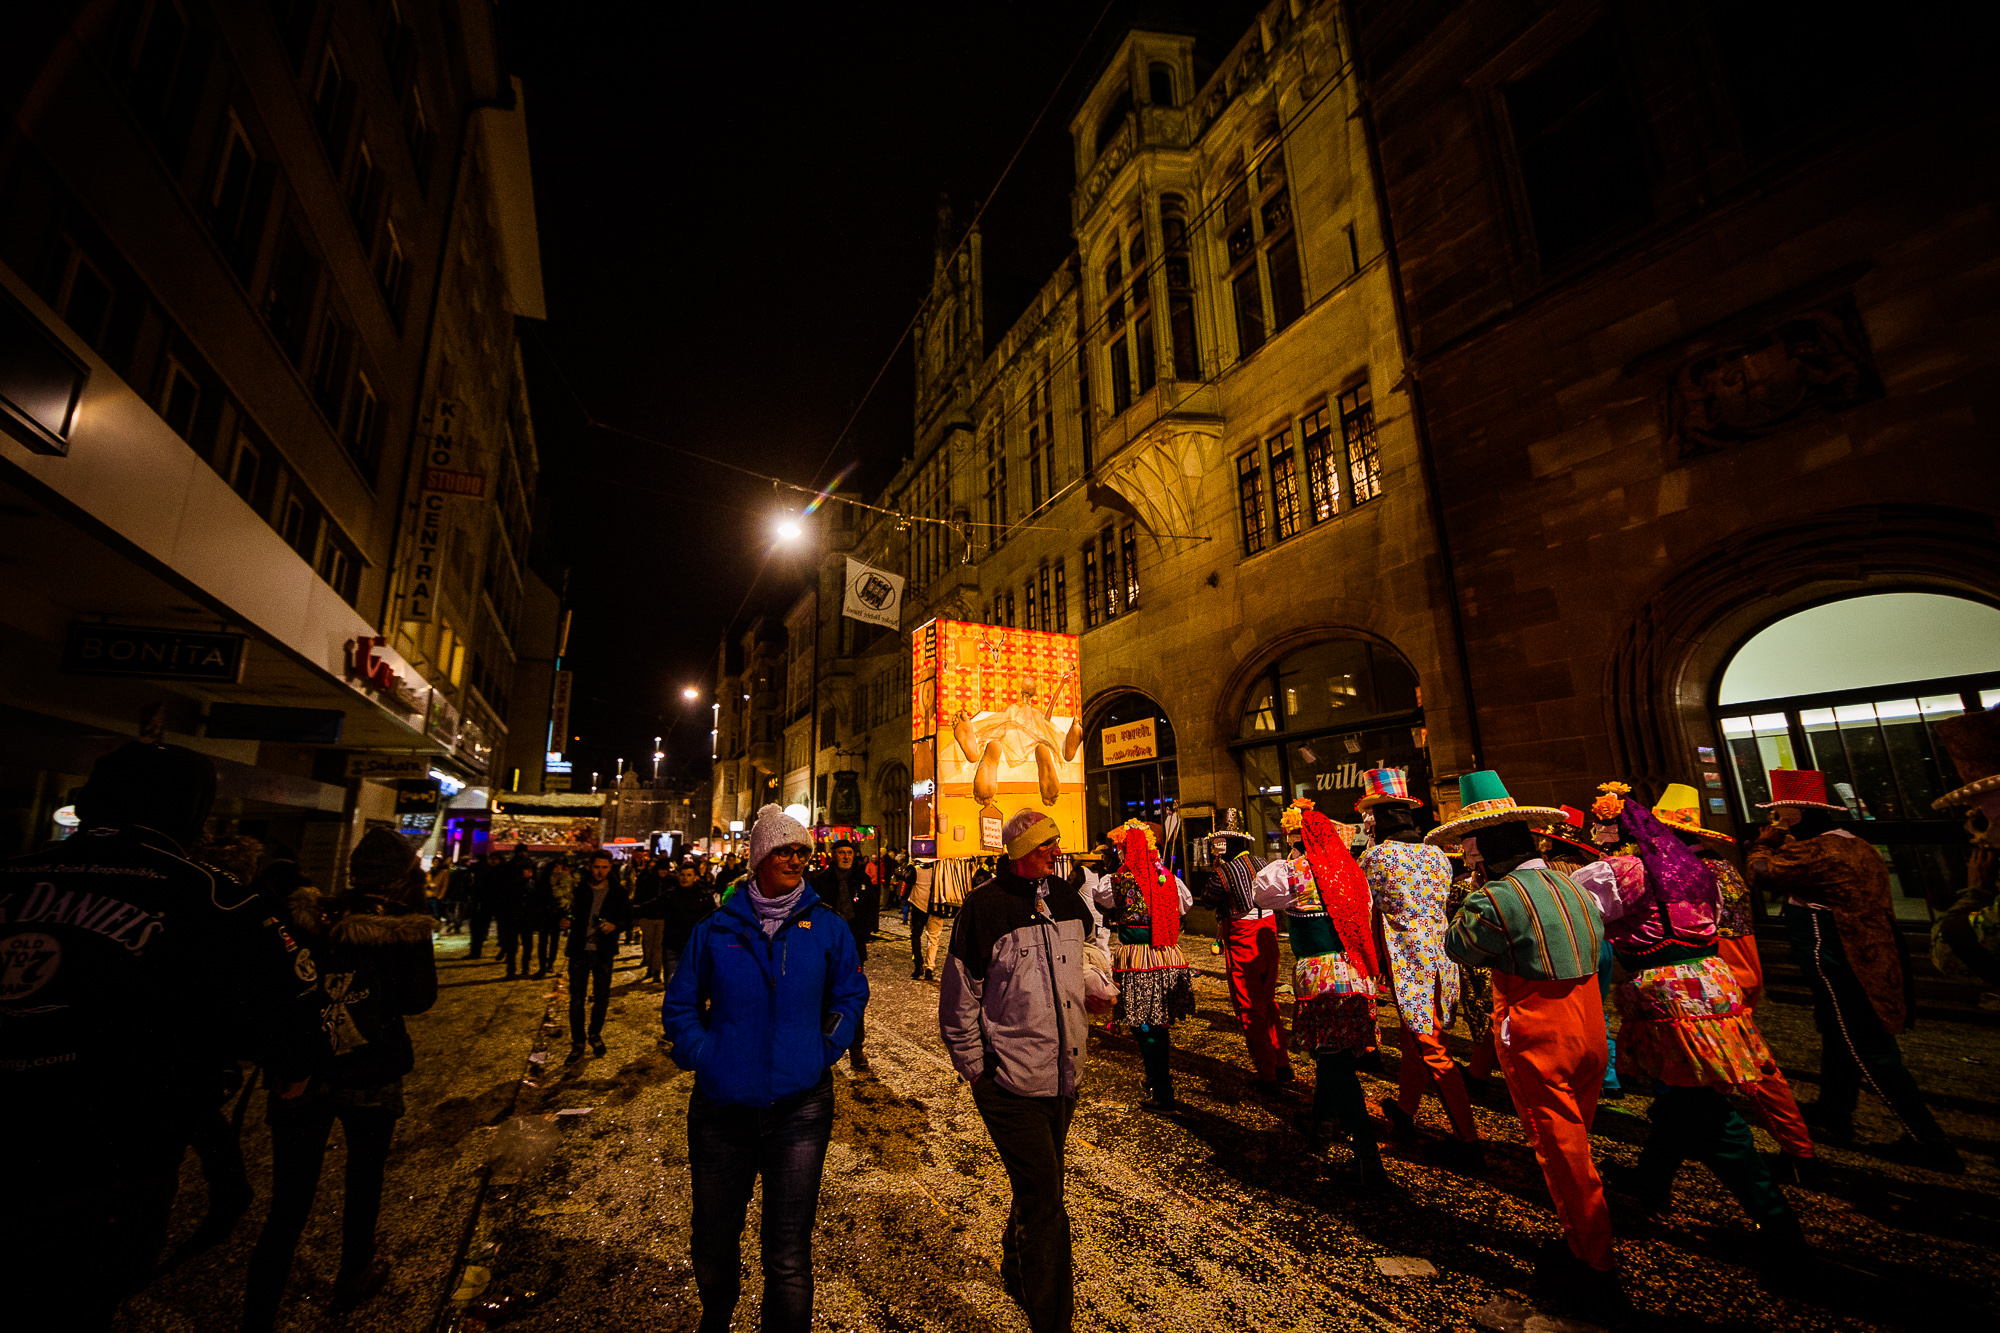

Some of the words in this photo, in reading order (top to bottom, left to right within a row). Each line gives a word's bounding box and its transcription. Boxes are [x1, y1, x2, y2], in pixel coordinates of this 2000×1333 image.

[433, 402, 456, 466] KINO
[426, 470, 483, 496] STUDIO
[411, 494, 443, 616] CENTRAL
[81, 637, 225, 671] BONITA
[11, 940, 44, 949] OLD
